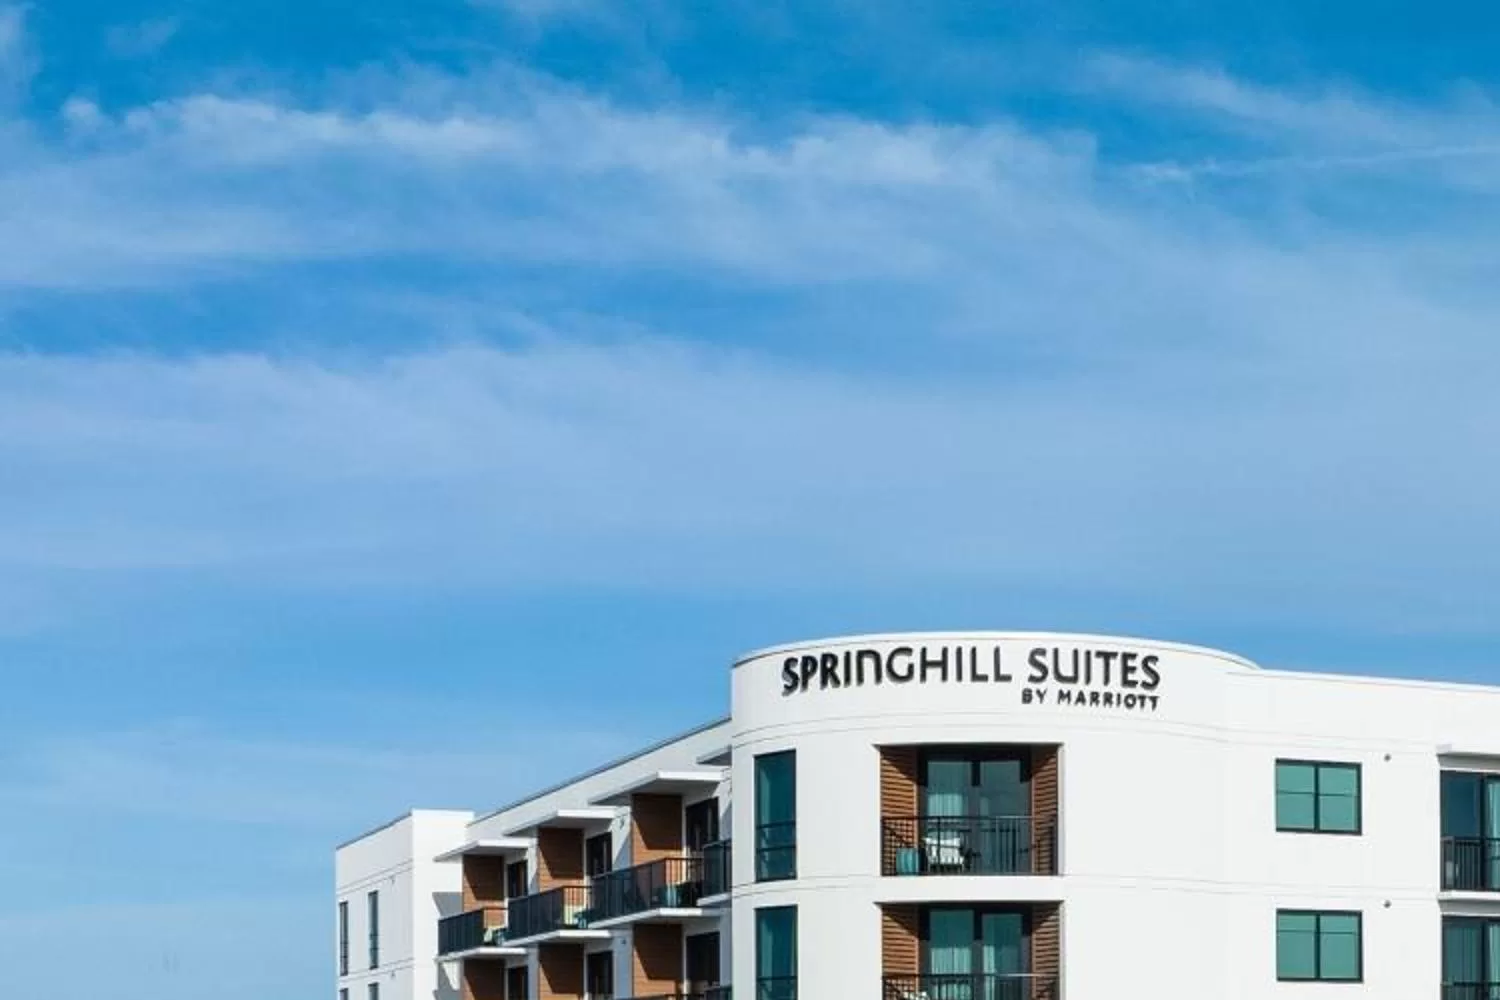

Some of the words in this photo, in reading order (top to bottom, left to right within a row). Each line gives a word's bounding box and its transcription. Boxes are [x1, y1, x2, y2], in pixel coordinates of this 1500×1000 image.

[782, 646, 1012, 696] SPRINGHILL
[1027, 648, 1161, 690] SUITES
[1021, 689, 1047, 704] BY
[1058, 690, 1159, 711] MARRIOTT
